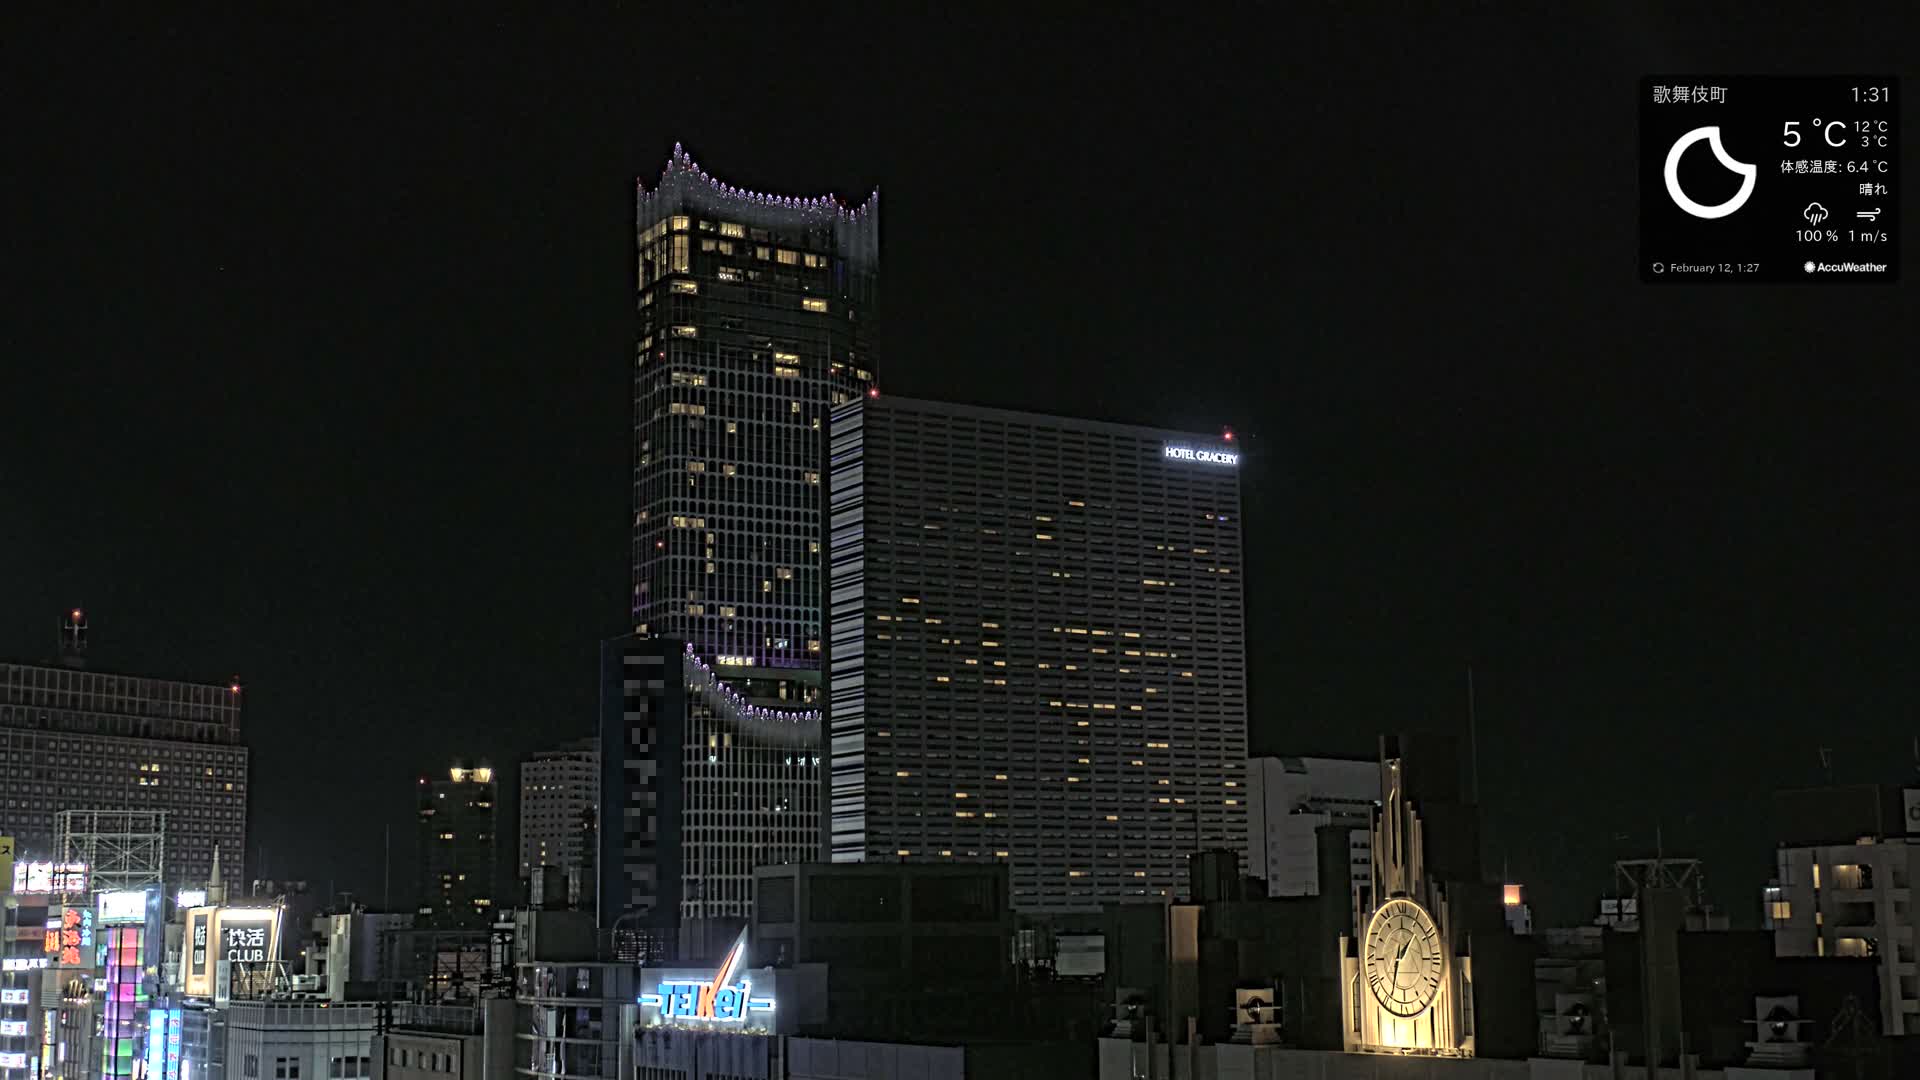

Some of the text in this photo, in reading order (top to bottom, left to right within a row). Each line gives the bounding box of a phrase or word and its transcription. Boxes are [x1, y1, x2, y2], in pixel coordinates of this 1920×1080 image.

[1165, 446, 1238, 465] HOTEL GRACERY
[229, 927, 265, 947] 快活
[228, 949, 264, 962] CLUB
